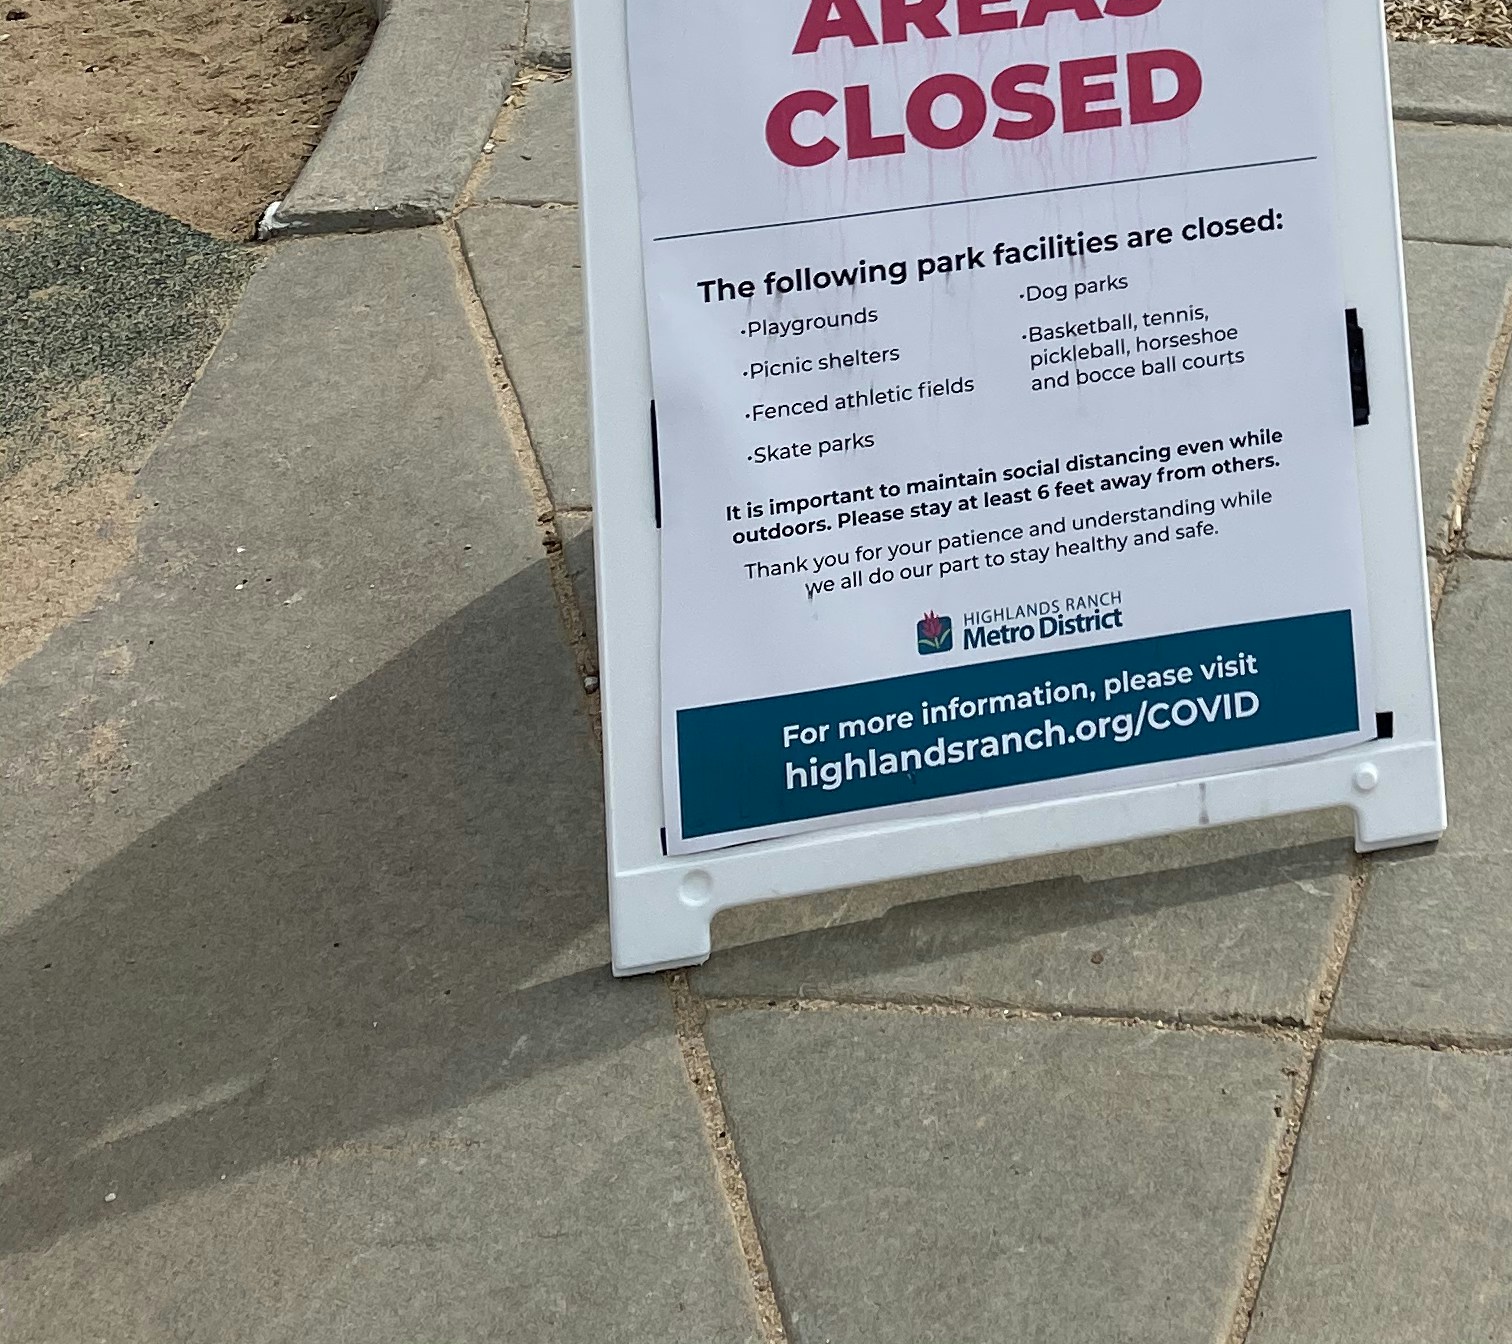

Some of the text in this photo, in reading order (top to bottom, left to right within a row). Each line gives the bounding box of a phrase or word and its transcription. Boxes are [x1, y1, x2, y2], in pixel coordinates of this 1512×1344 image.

[765, 49, 1203, 168] CLOSED
[696, 207, 1284, 304] The following park facilities are closed:
[1074, 274, 1129, 300] parks
[1028, 304, 1209, 343] Basketball, tennis,
[818, 348, 900, 371] shelters
[1030, 327, 1238, 371] pickleball, horseshoe
[1031, 350, 1245, 391] and bocce ball courts
[834, 384, 913, 410] athletic
[917, 376, 975, 399] fields
[818, 432, 875, 458] parks
[726, 427, 1283, 522] It is important to maintain social distancing even while
[732, 455, 1280, 545] outdoors. Please stay at least 6 feet away from others.
[743, 488, 1273, 579] Thank you for your patience and understanding while
[804, 520, 1219, 596] we all do our part to stay healthy and safe.
[963, 590, 1122, 627] HIGHLANDS RANCH
[963, 607, 1124, 651] Metro District
[783, 652, 1259, 748] For more information, please visit
[786, 691, 1260, 790] highlandsranch.org/COVID
